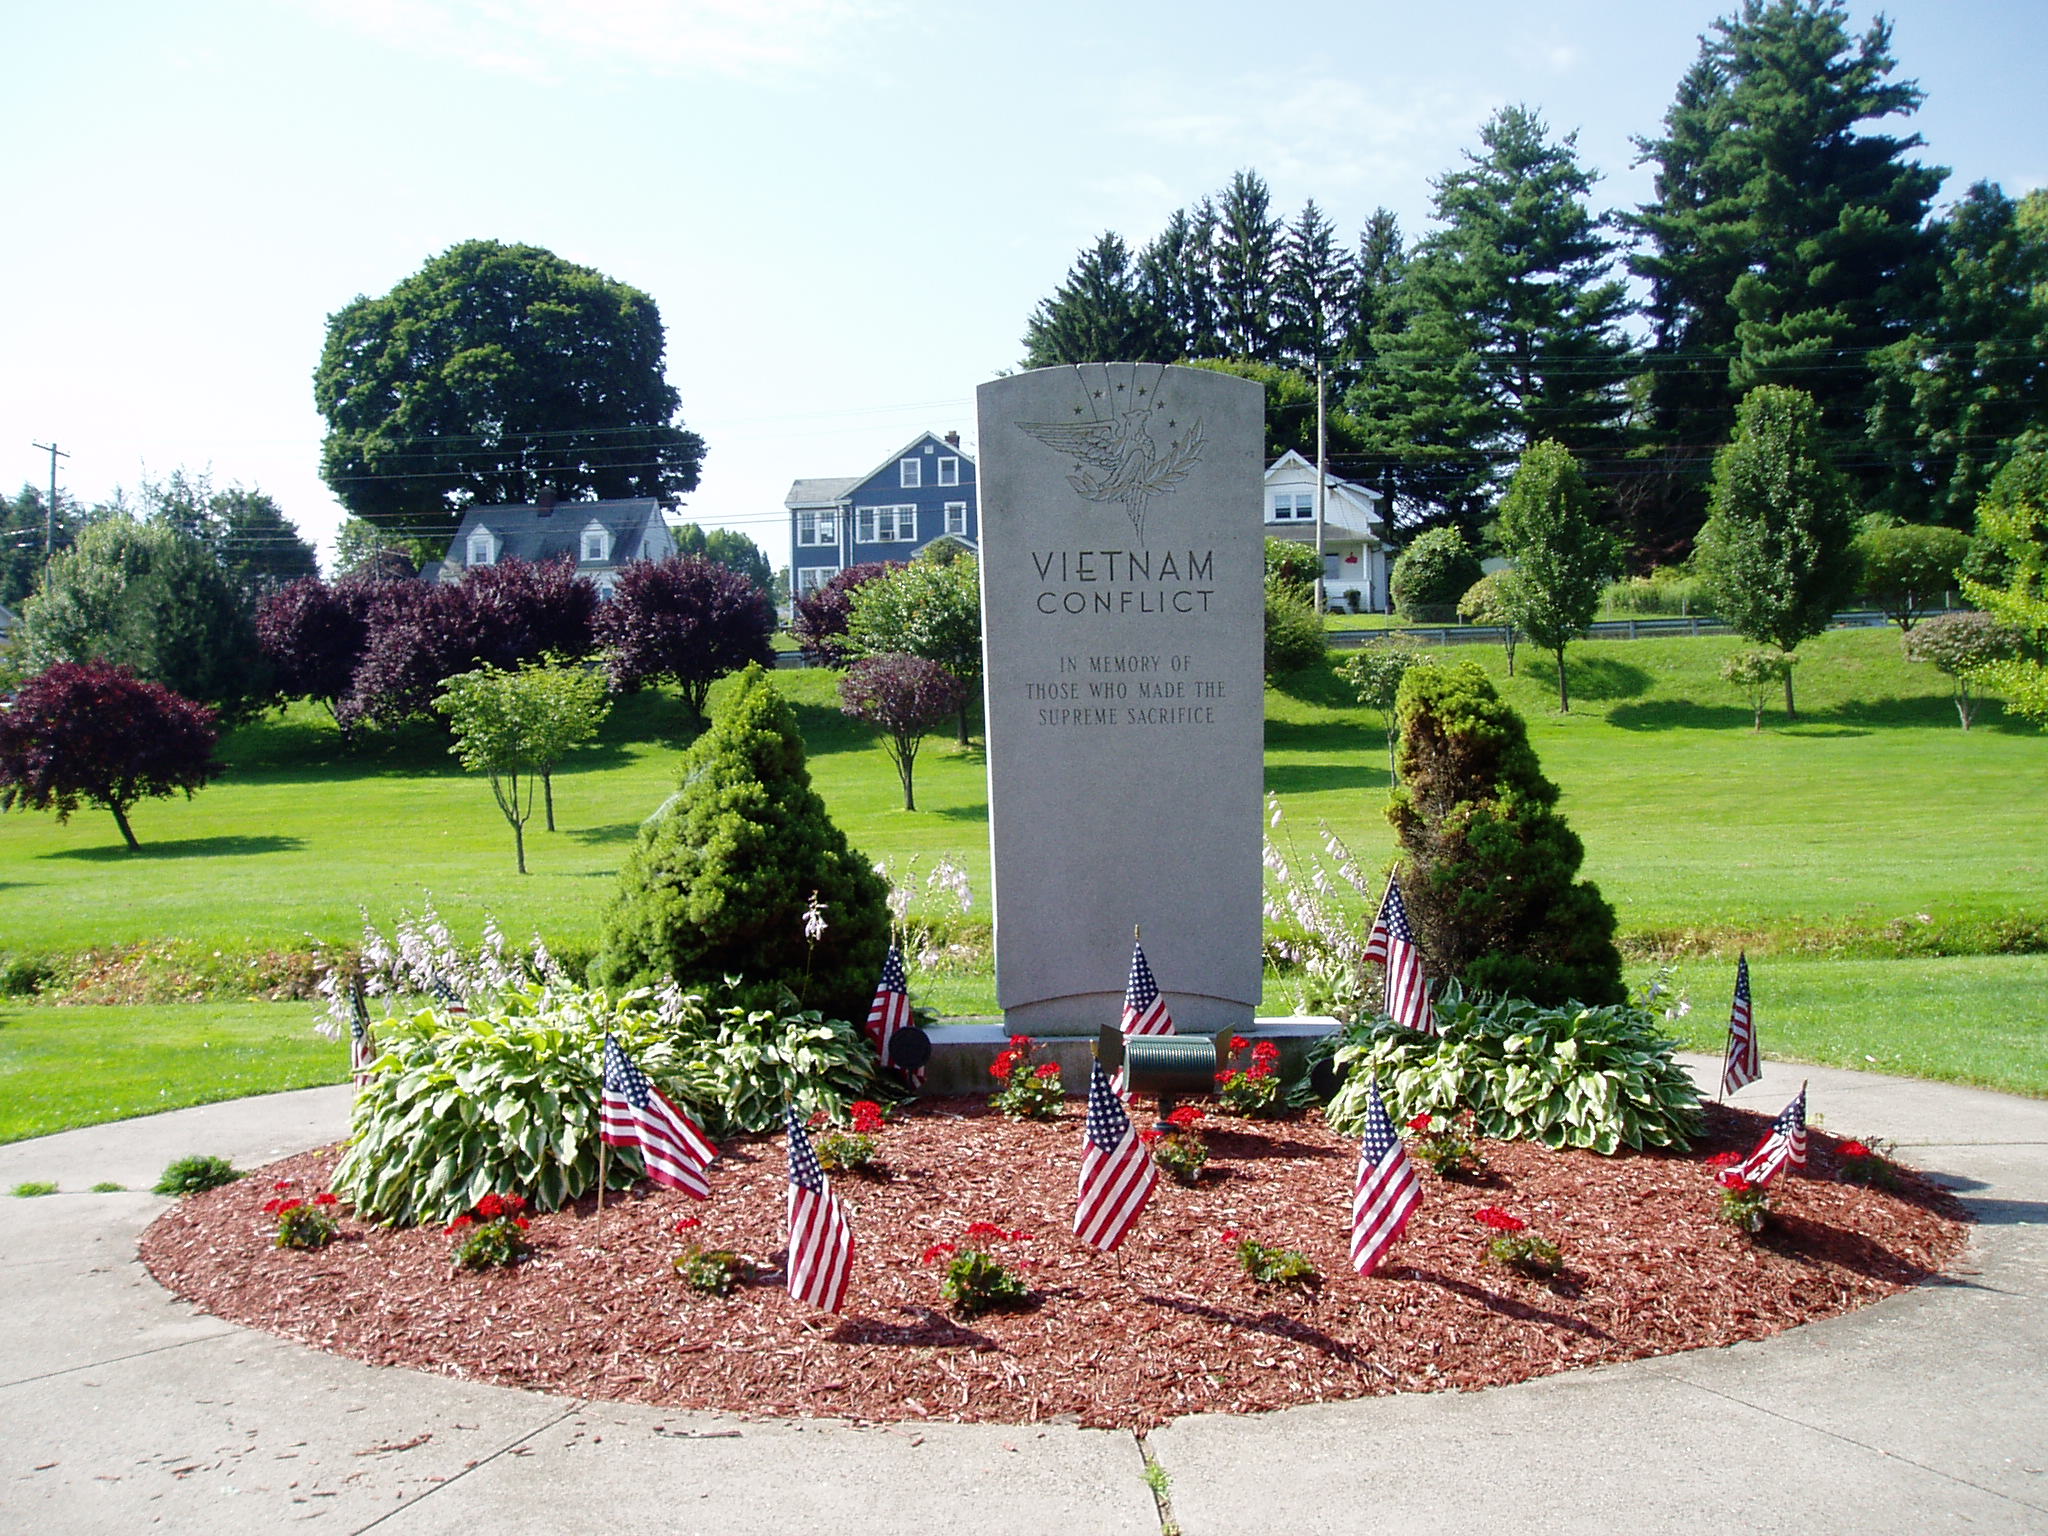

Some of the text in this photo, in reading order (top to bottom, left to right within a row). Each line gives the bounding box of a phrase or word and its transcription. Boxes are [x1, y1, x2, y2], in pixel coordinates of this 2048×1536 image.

[1031, 550, 1214, 582] VIETNAM
[1036, 590, 1215, 614] CONFLICT
[1060, 655, 1192, 673] IN MEMORY OF
[1026, 680, 1226, 700] THOSE WHO MADE THE
[1039, 706, 1215, 726] SUPREME SACRIFICE
